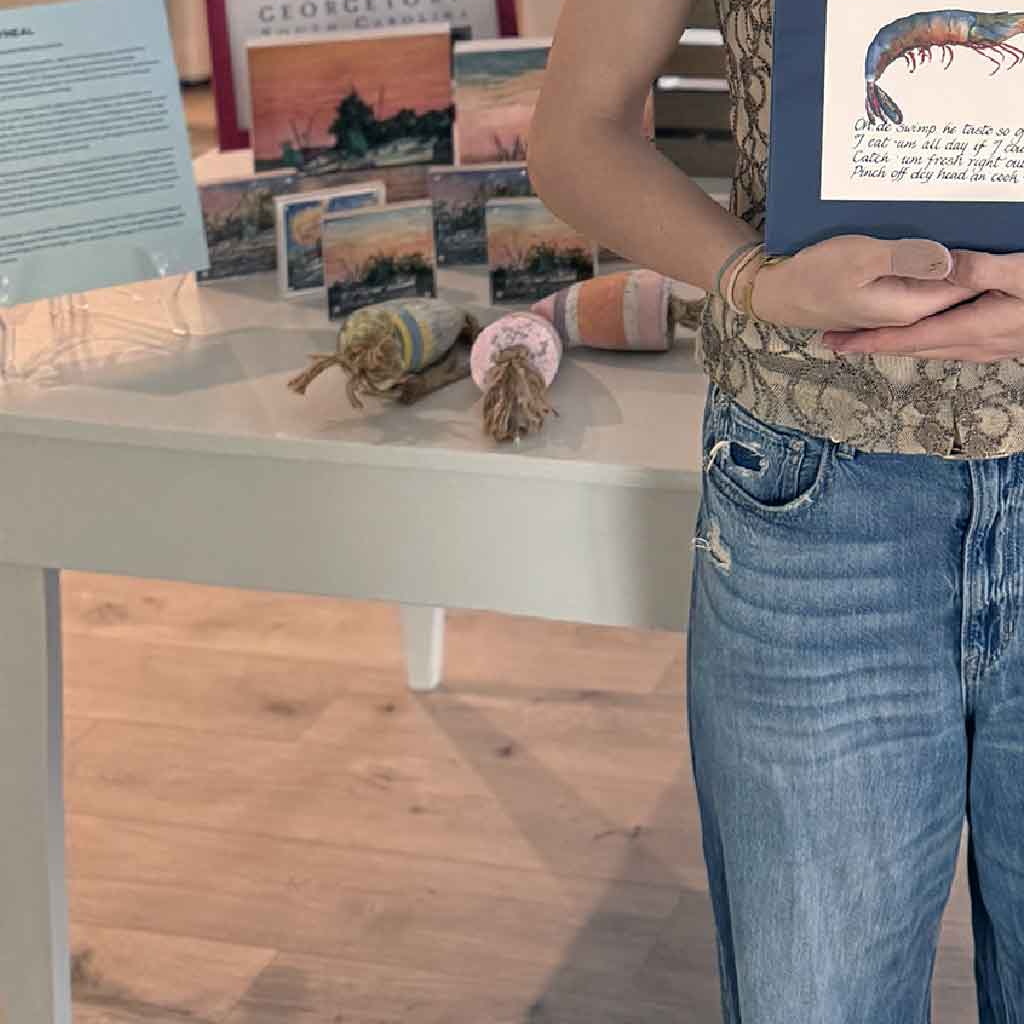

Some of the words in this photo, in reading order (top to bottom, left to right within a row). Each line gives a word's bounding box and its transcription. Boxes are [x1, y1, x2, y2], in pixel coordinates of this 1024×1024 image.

[995, 127, 1010, 137] so
[868, 137, 889, 149] eat
[922, 137, 941, 149] all
[945, 138, 969, 156] day
[852, 150, 888, 163] Catch
[925, 154, 963, 170] fresh
[968, 156, 1003, 173] right
[851, 164, 886, 178] Pinch
[891, 166, 911, 181] off
[936, 167, 969, 180] head
